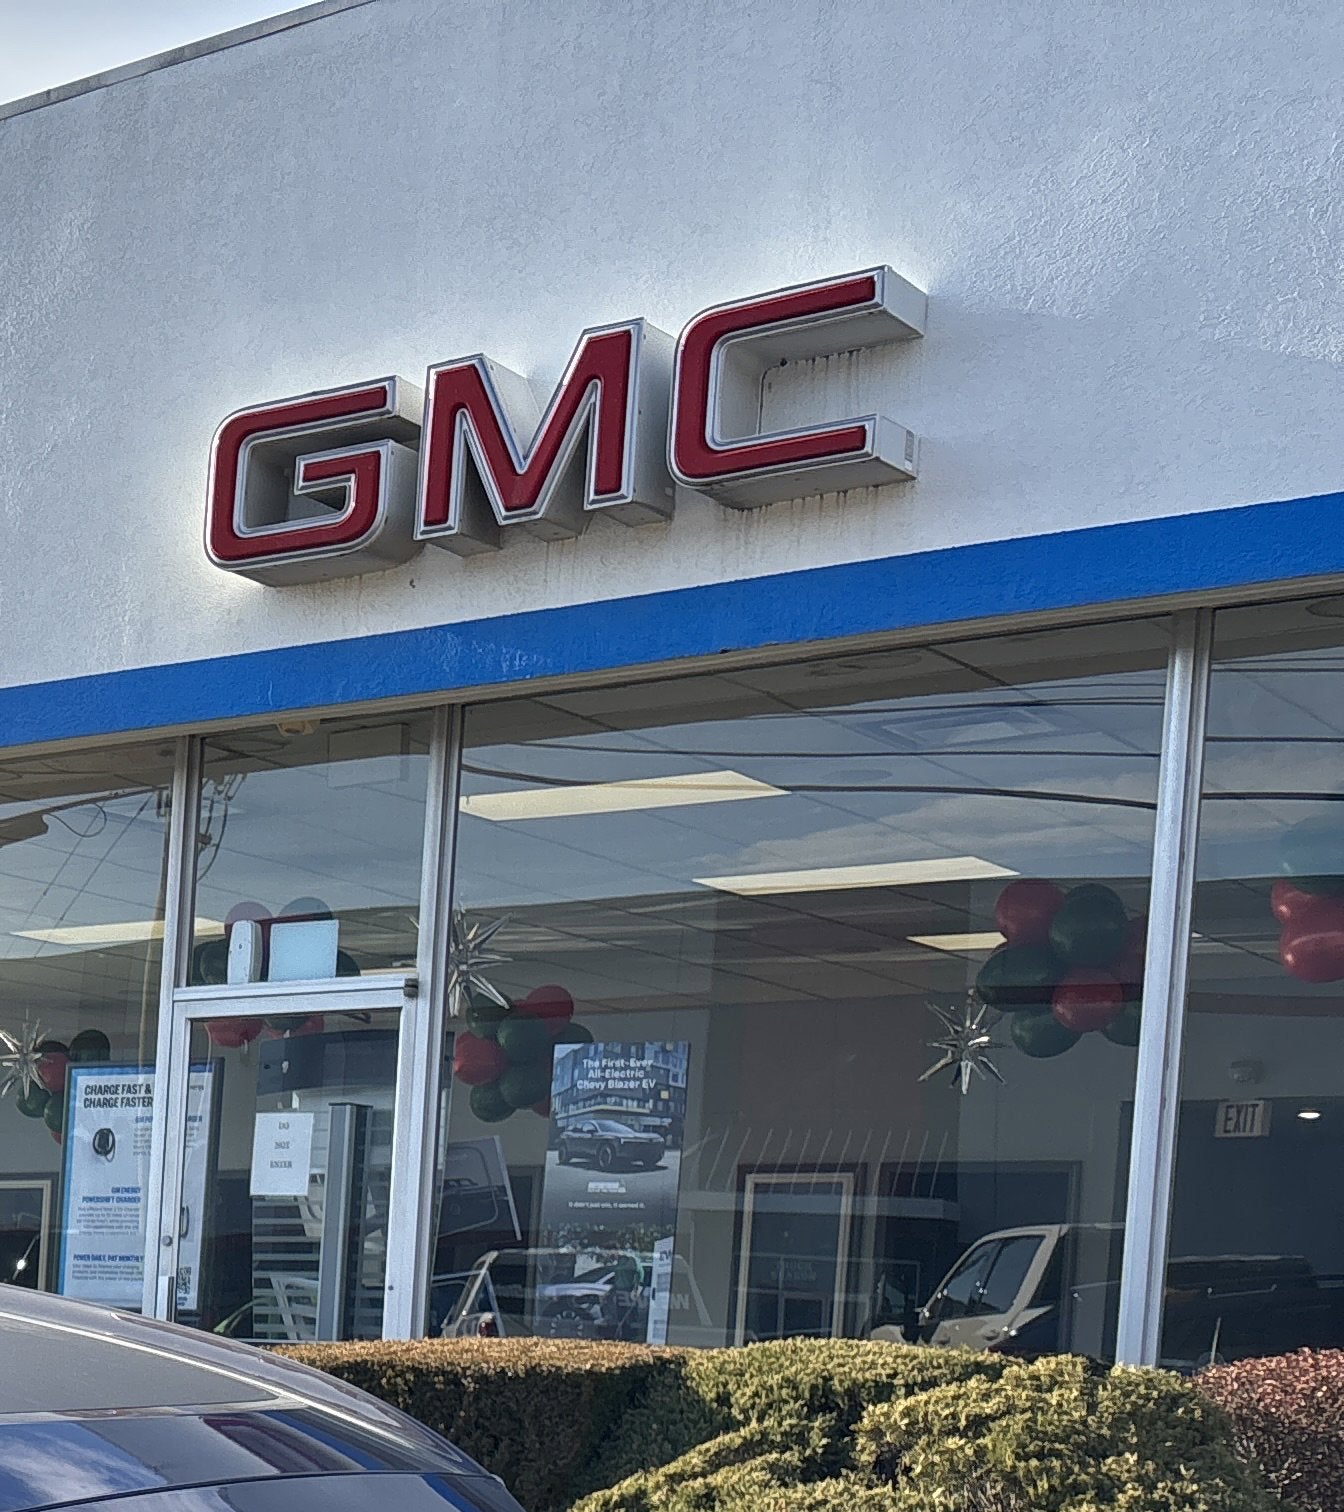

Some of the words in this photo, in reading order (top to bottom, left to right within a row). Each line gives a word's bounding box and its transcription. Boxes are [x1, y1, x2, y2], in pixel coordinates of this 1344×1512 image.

[203, 264, 912, 575] GMC
[583, 1058, 599, 1069] The
[601, 1058, 653, 1069] First-Ever
[588, 1069, 645, 1078] All-Electric
[84, 1084, 119, 1096] CHARGE
[121, 1083, 142, 1095] FAST
[144, 1083, 152, 1095] &
[577, 1080, 606, 1090] Chevy
[608, 1079, 640, 1089] Blazer
[642, 1079, 656, 1089] EV
[83, 1097, 118, 1108] CHARGE
[120, 1096, 153, 1108] FASTER
[1223, 1103, 1259, 1134] EXIT
[274, 1141, 290, 1150] NOT
[269, 1160, 292, 1169] ENTER
